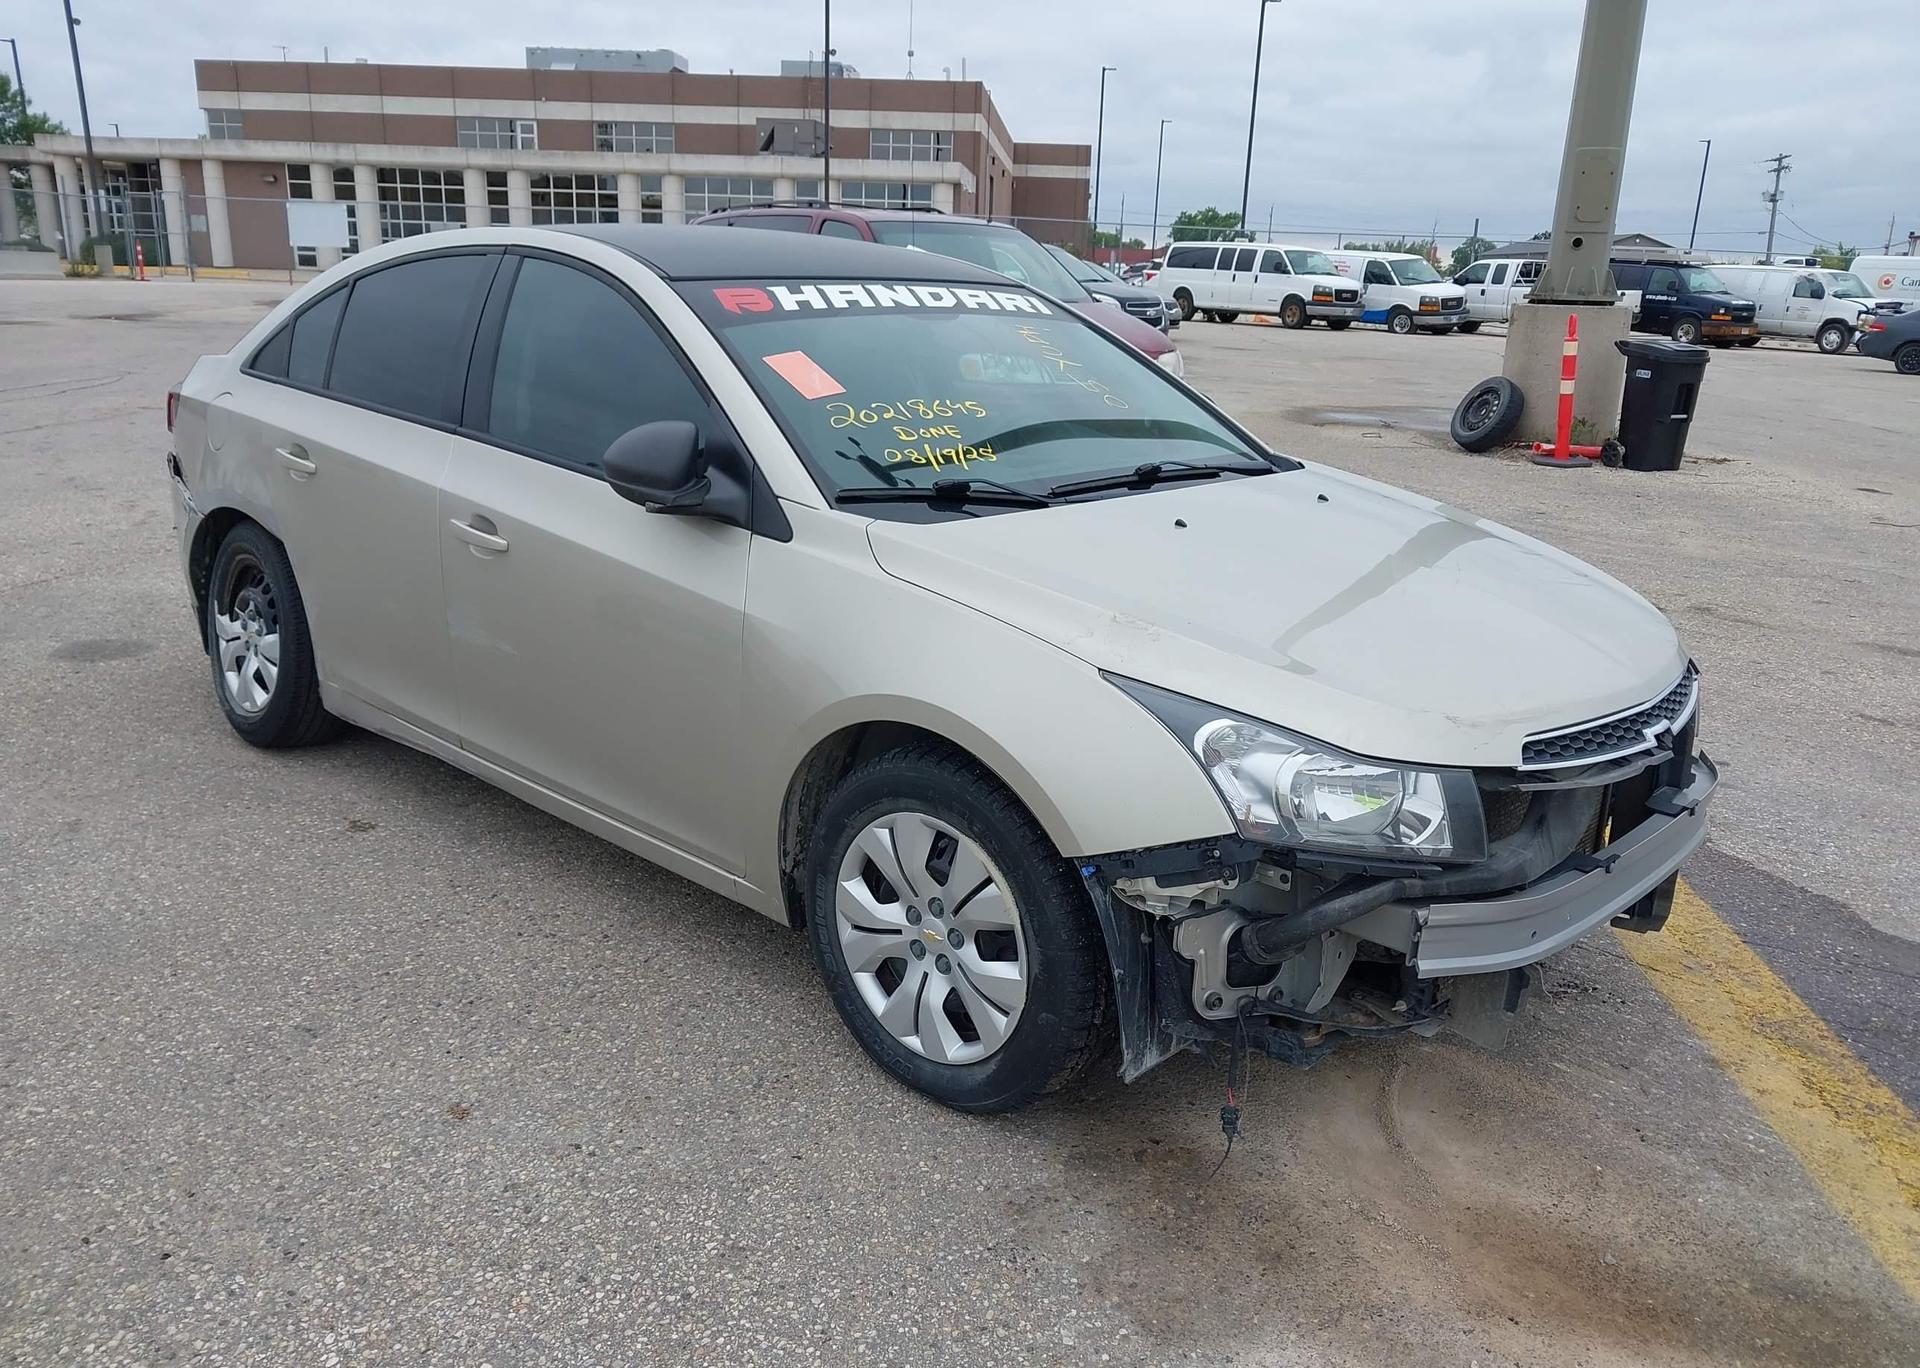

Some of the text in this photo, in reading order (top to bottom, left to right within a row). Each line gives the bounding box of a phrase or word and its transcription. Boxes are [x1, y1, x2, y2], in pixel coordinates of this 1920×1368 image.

[712, 284, 1053, 315] BHANDARI
[826, 398, 987, 430] 20218645
[893, 425, 962, 442] DONE
[884, 441, 998, 473] 08/19/25
